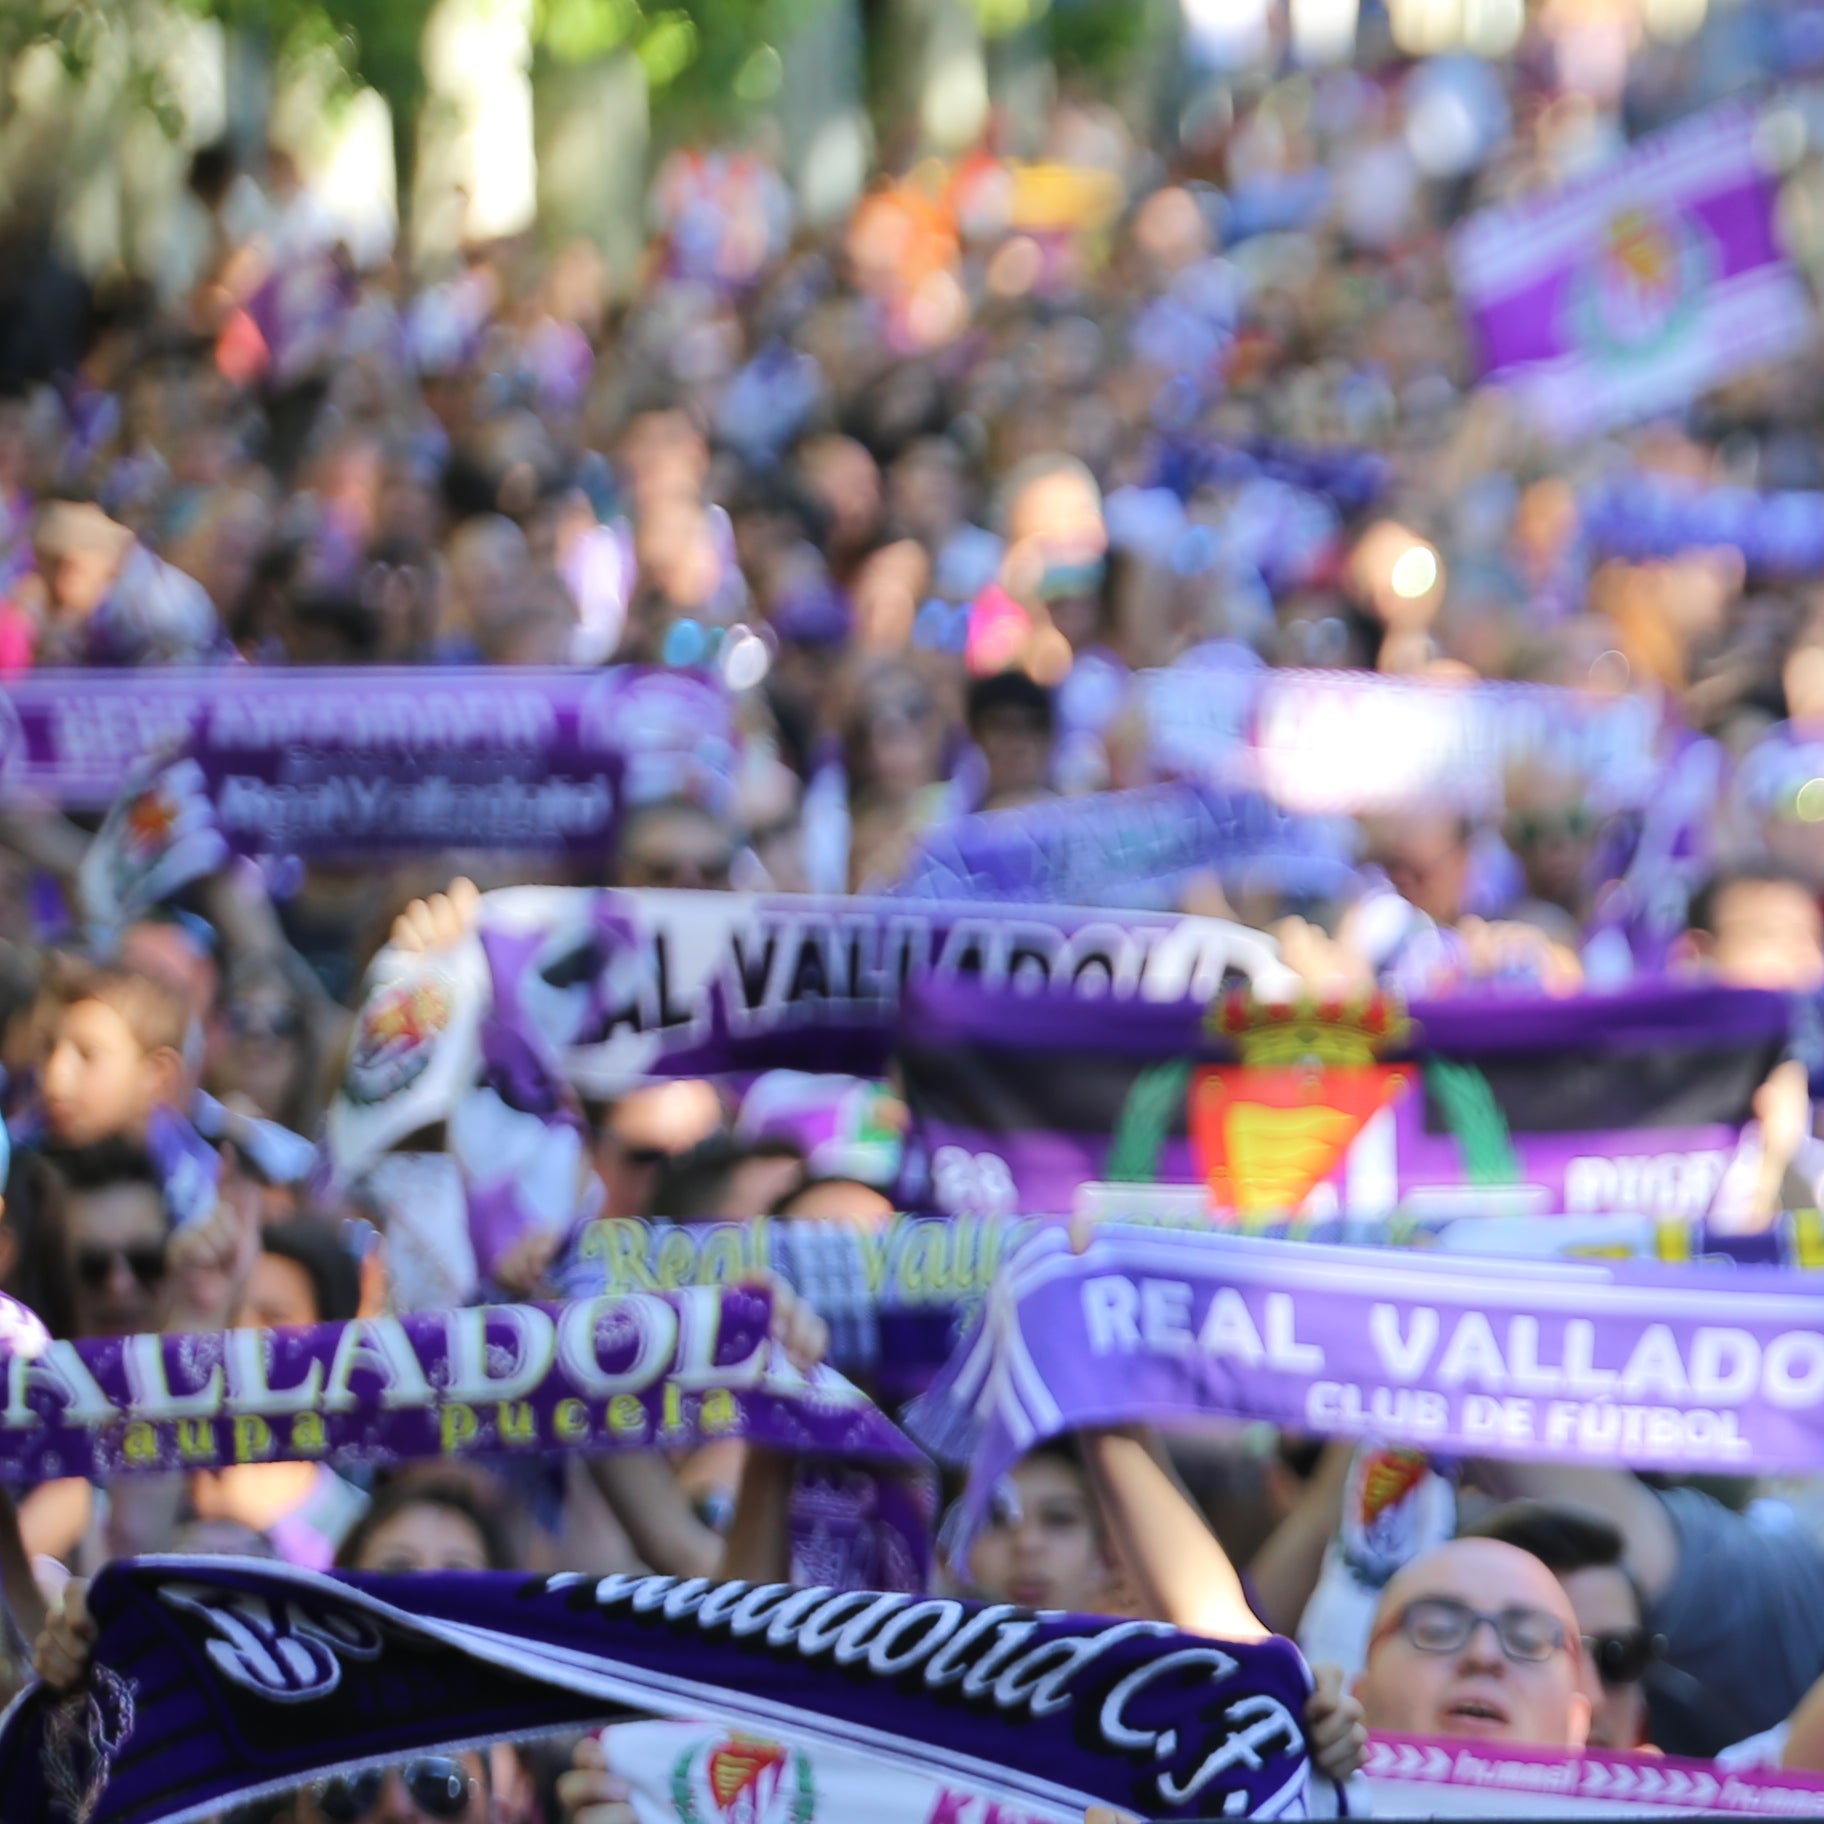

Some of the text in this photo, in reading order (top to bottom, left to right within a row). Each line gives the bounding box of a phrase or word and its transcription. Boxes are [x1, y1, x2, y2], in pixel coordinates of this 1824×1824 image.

[1082, 1273, 1325, 1371] REAL
[1306, 1379, 1446, 1434] CLUB
[1462, 1392, 1535, 1441] DE
